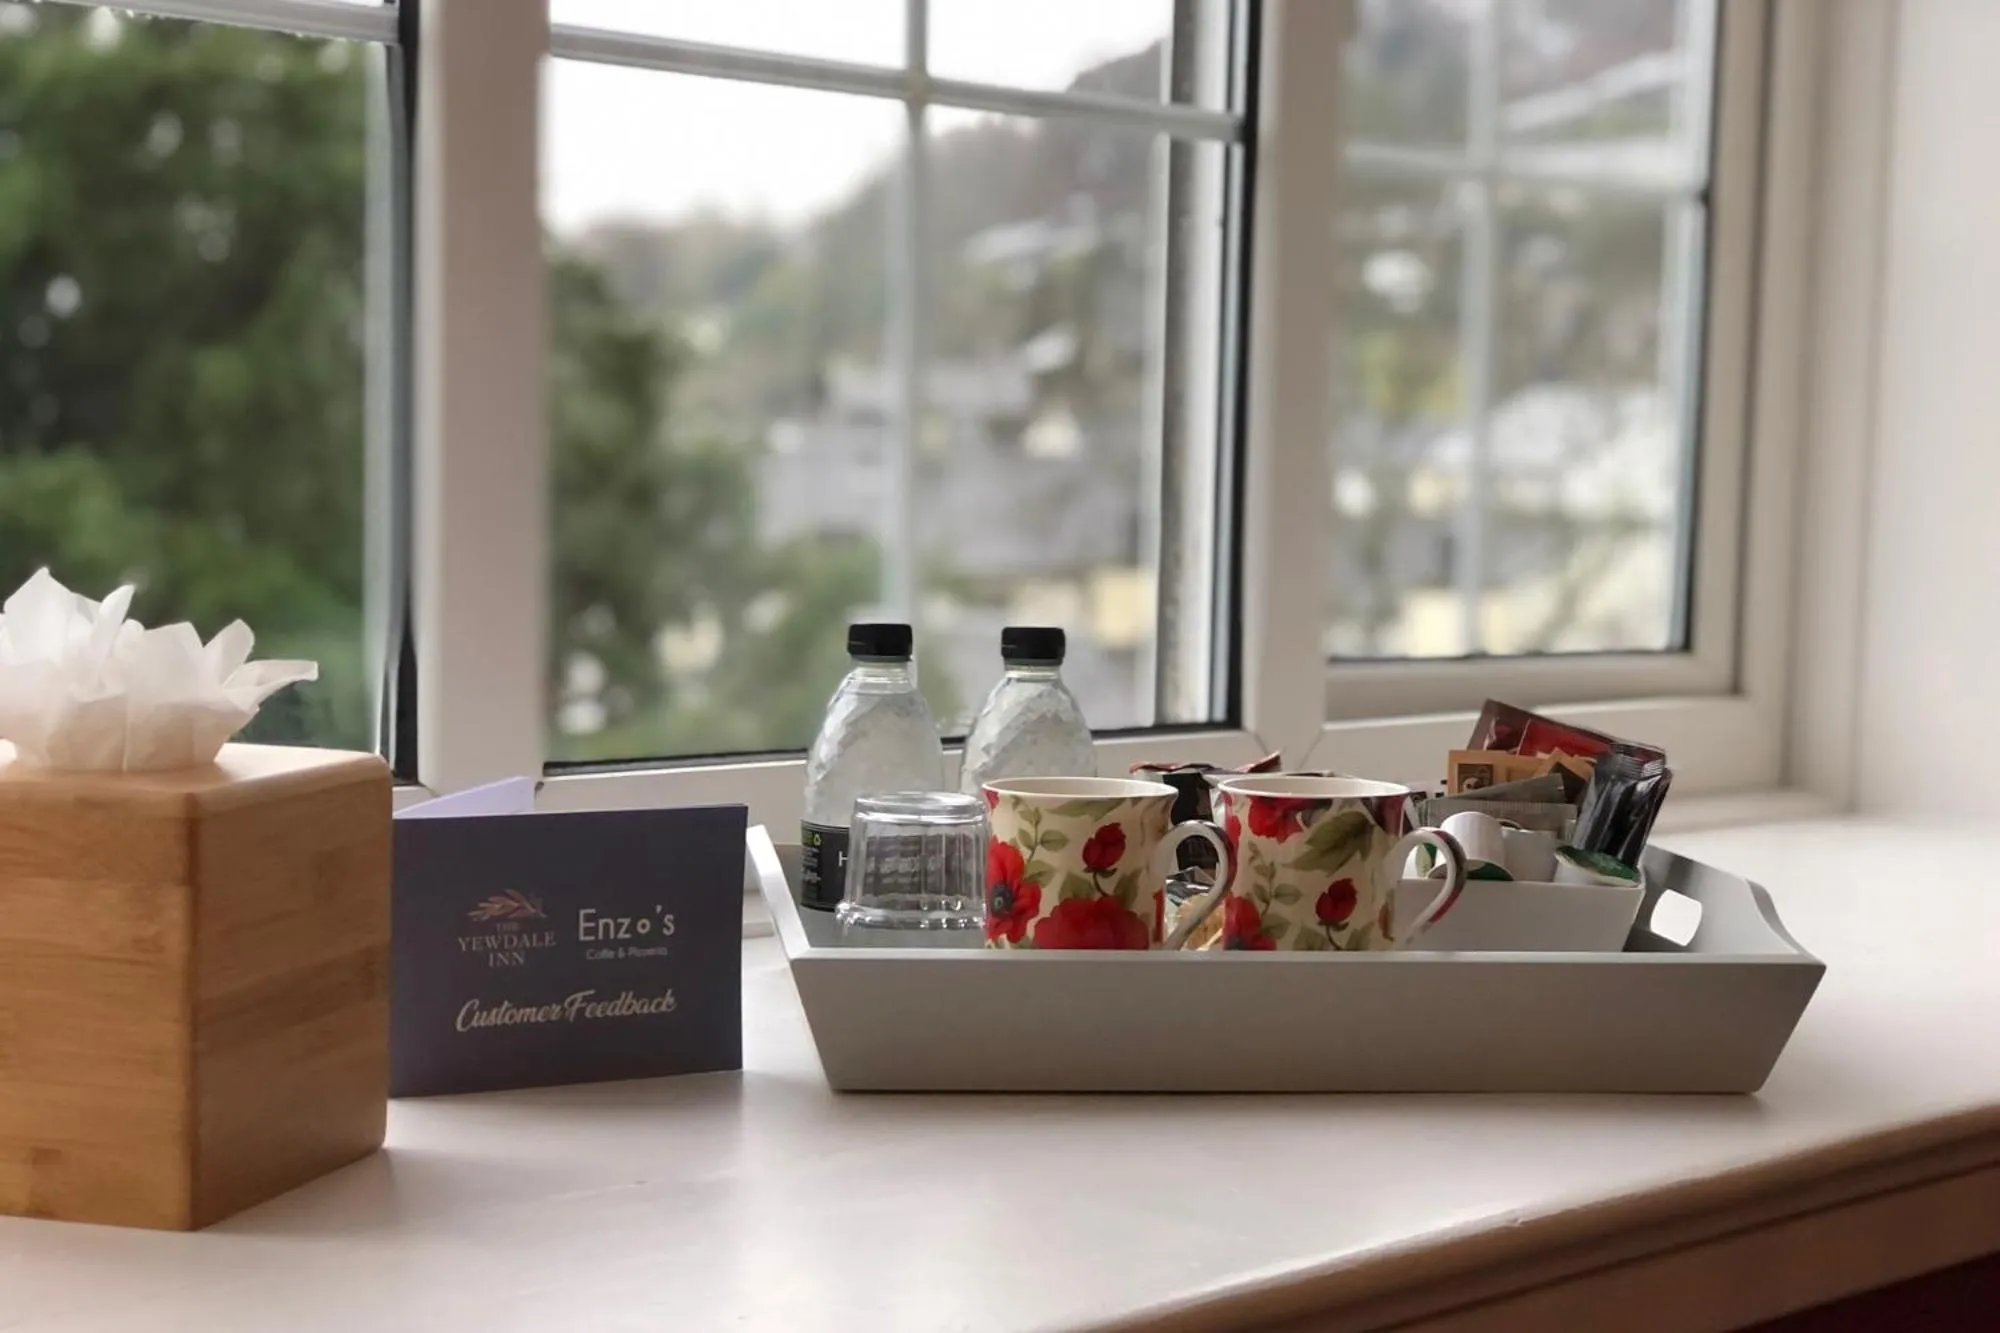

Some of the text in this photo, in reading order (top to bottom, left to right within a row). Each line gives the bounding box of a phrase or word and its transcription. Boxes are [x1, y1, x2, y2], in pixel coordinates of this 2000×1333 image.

[578, 904, 676, 941] Enzo's
[458, 931, 557, 952] YEWDALE
[488, 951, 525, 967] INN
[455, 988, 677, 1032] Customer Feedback
